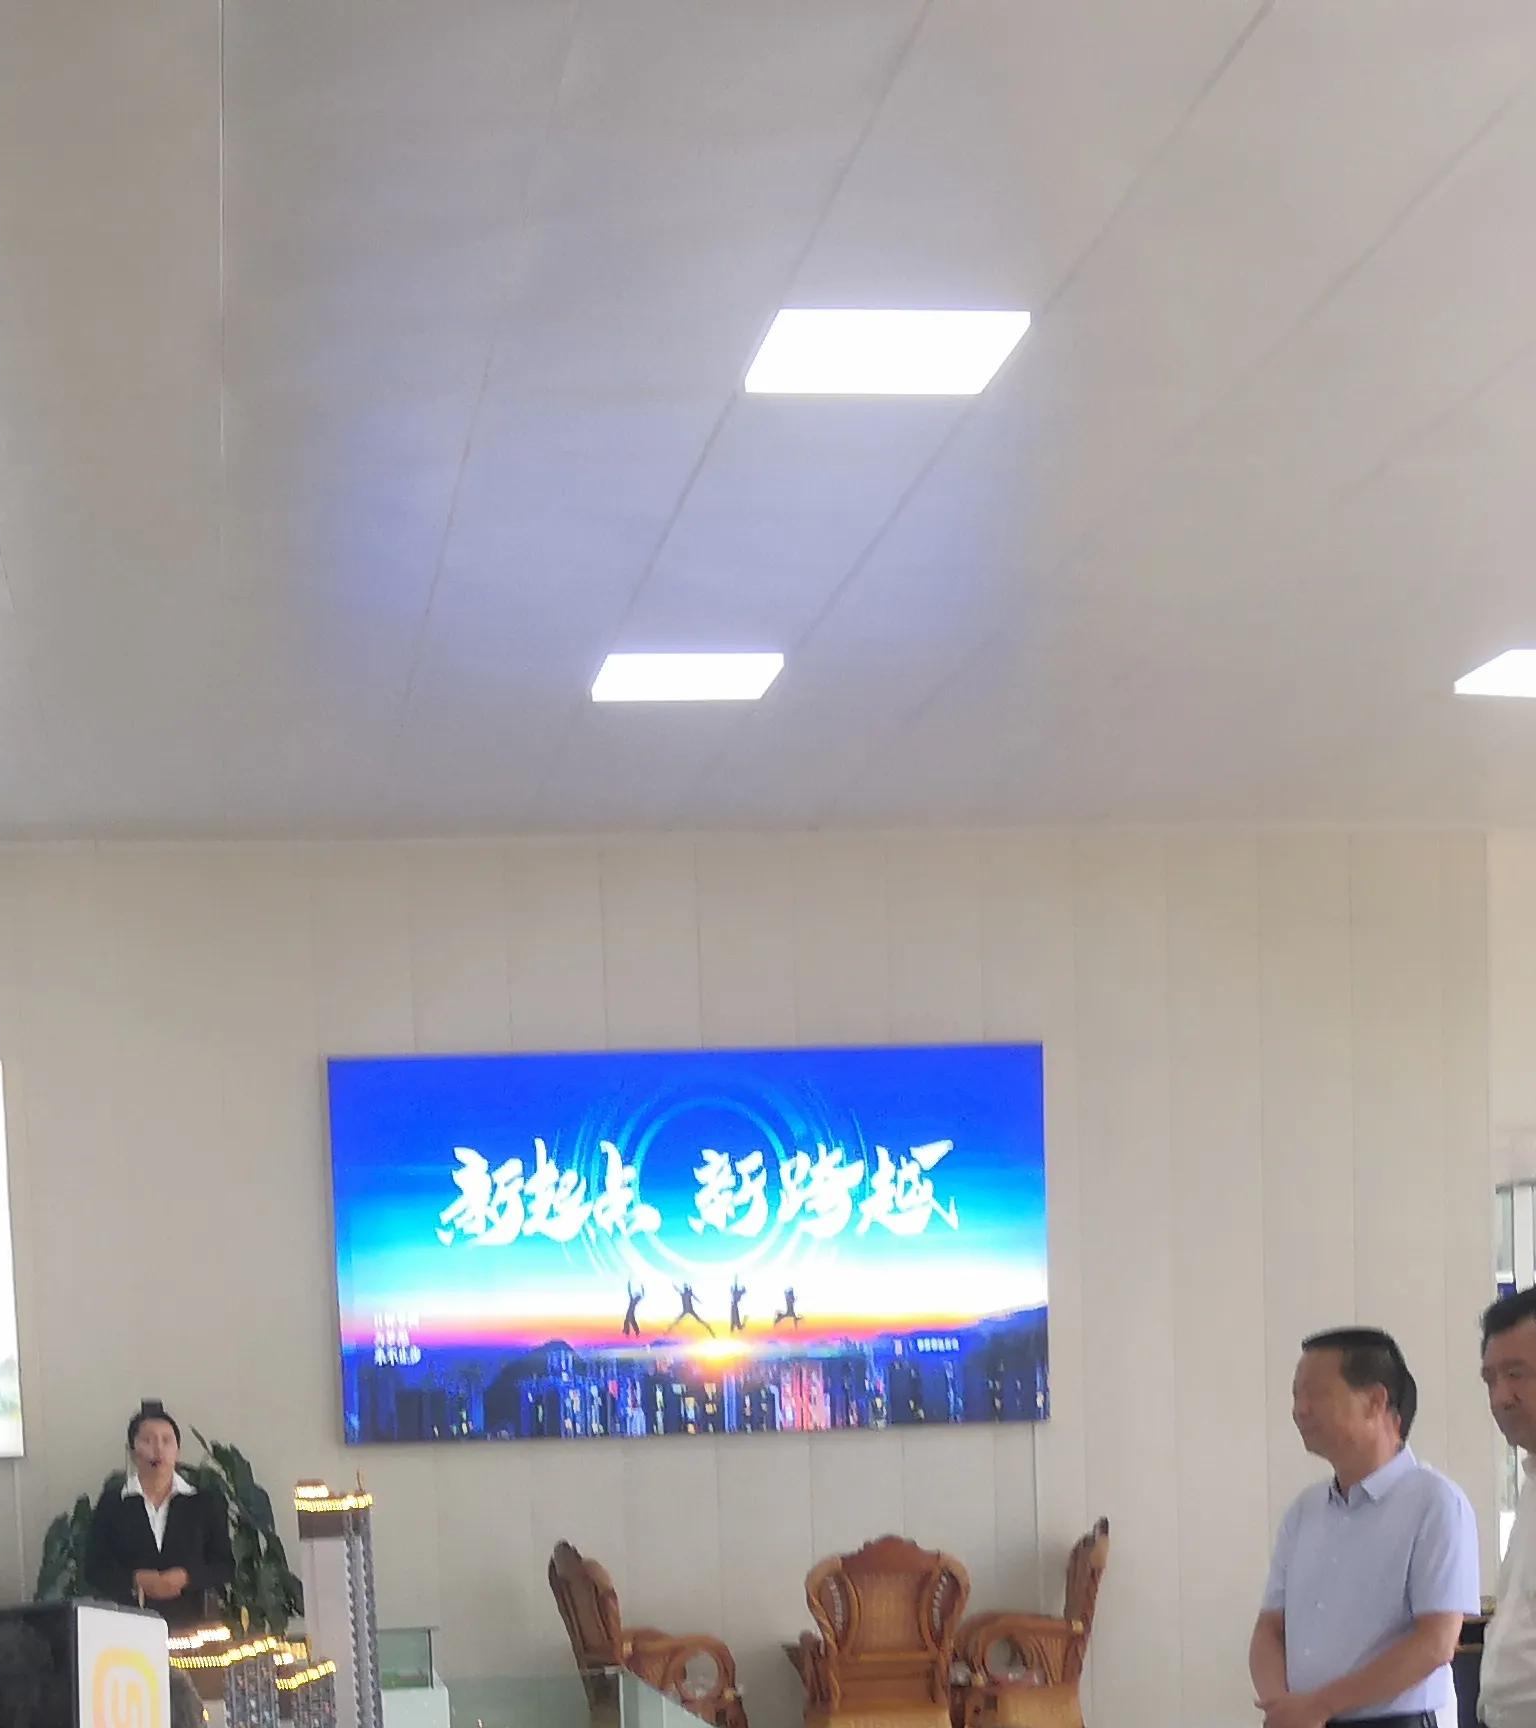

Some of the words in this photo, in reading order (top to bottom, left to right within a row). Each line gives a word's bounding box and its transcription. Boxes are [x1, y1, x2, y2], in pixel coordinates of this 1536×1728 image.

[435, 1136, 662, 1247] 新起点
[687, 1138, 960, 1242] 新跨越
